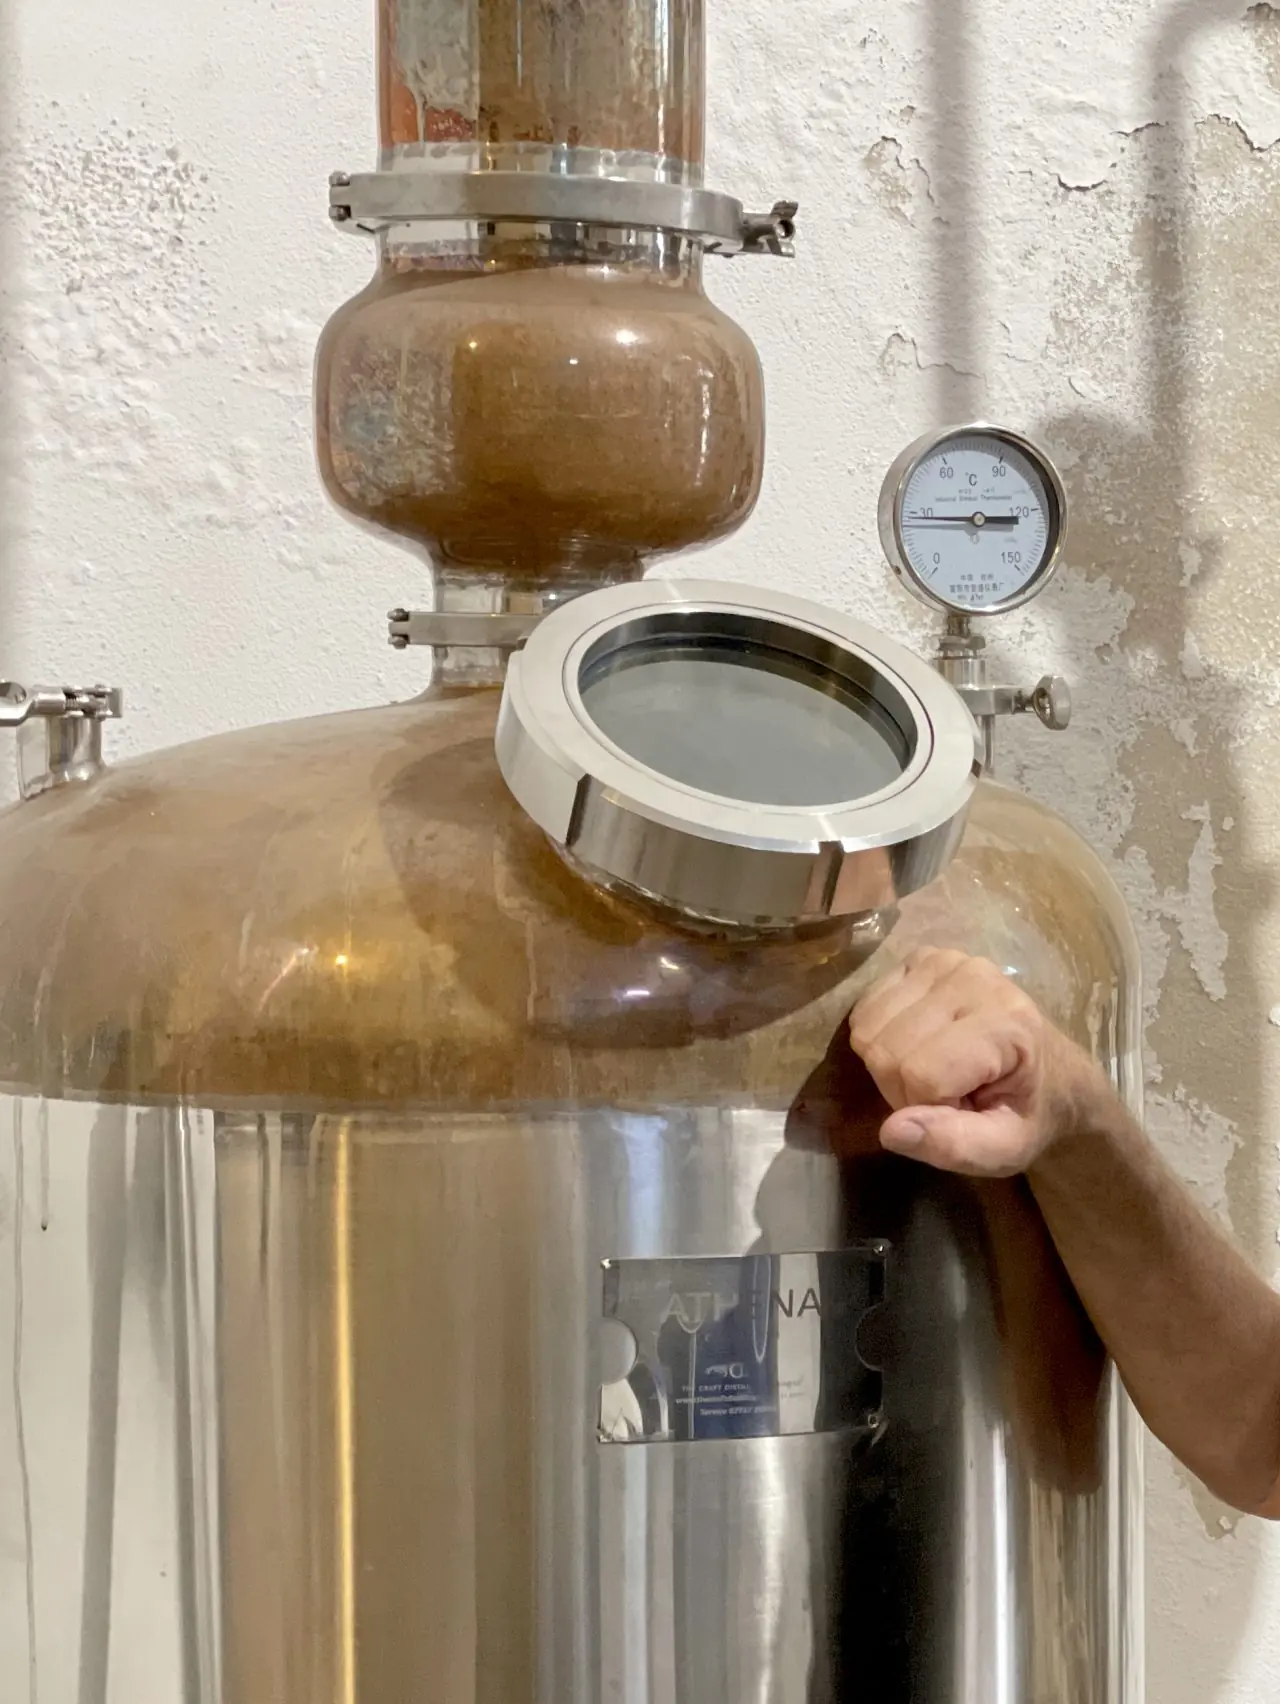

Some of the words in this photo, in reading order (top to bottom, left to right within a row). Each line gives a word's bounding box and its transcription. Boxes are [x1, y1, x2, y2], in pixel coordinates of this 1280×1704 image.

[939, 467, 954, 479] 60
[991, 466, 1006, 478] 90
[919, 507, 934, 519] 30
[1009, 506, 1030, 519] 120
[932, 552, 941, 565] 0
[1001, 551, 1022, 564] 150
